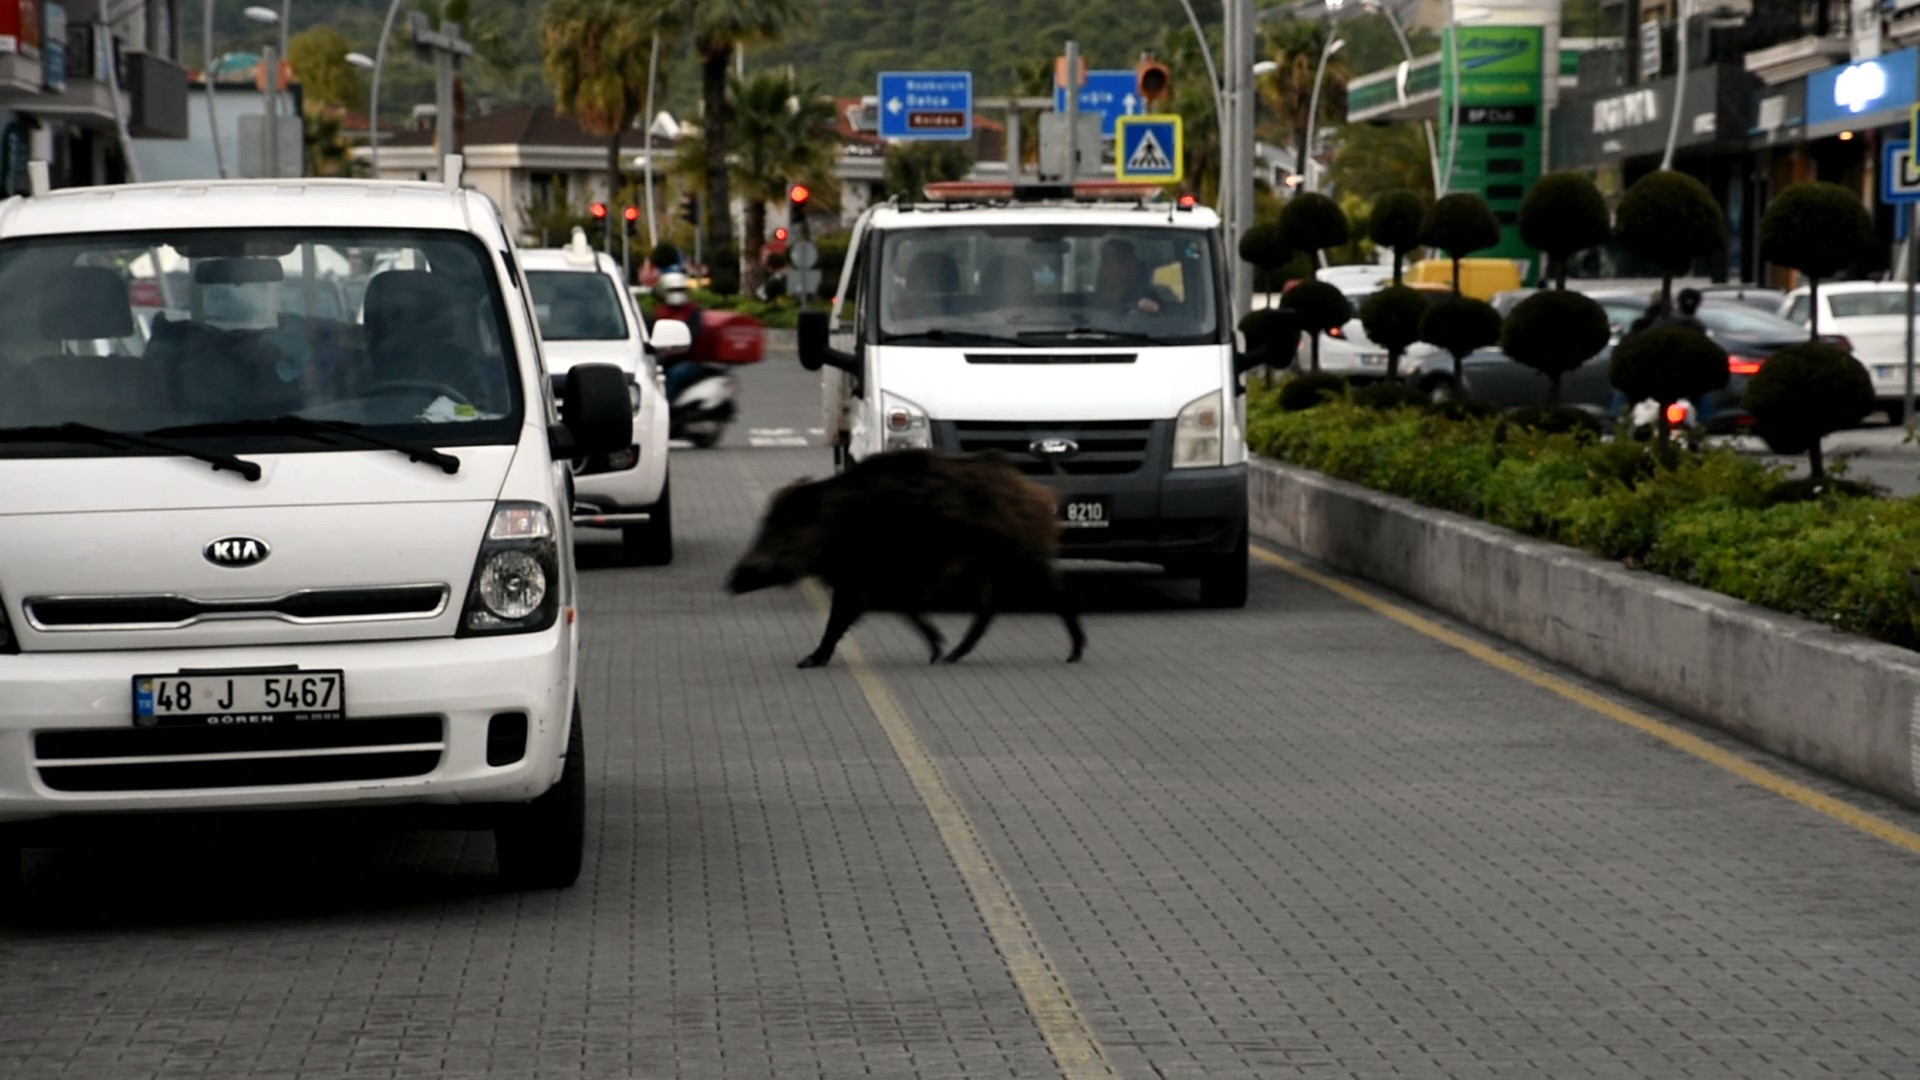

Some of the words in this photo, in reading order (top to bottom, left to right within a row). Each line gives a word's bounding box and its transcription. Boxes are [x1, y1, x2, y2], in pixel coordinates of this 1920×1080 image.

[1067, 502, 1102, 521] 8210
[213, 541, 259, 560] KIA
[157, 681, 192, 711] 48
[217, 679, 234, 710] J
[264, 677, 336, 709] 5467
